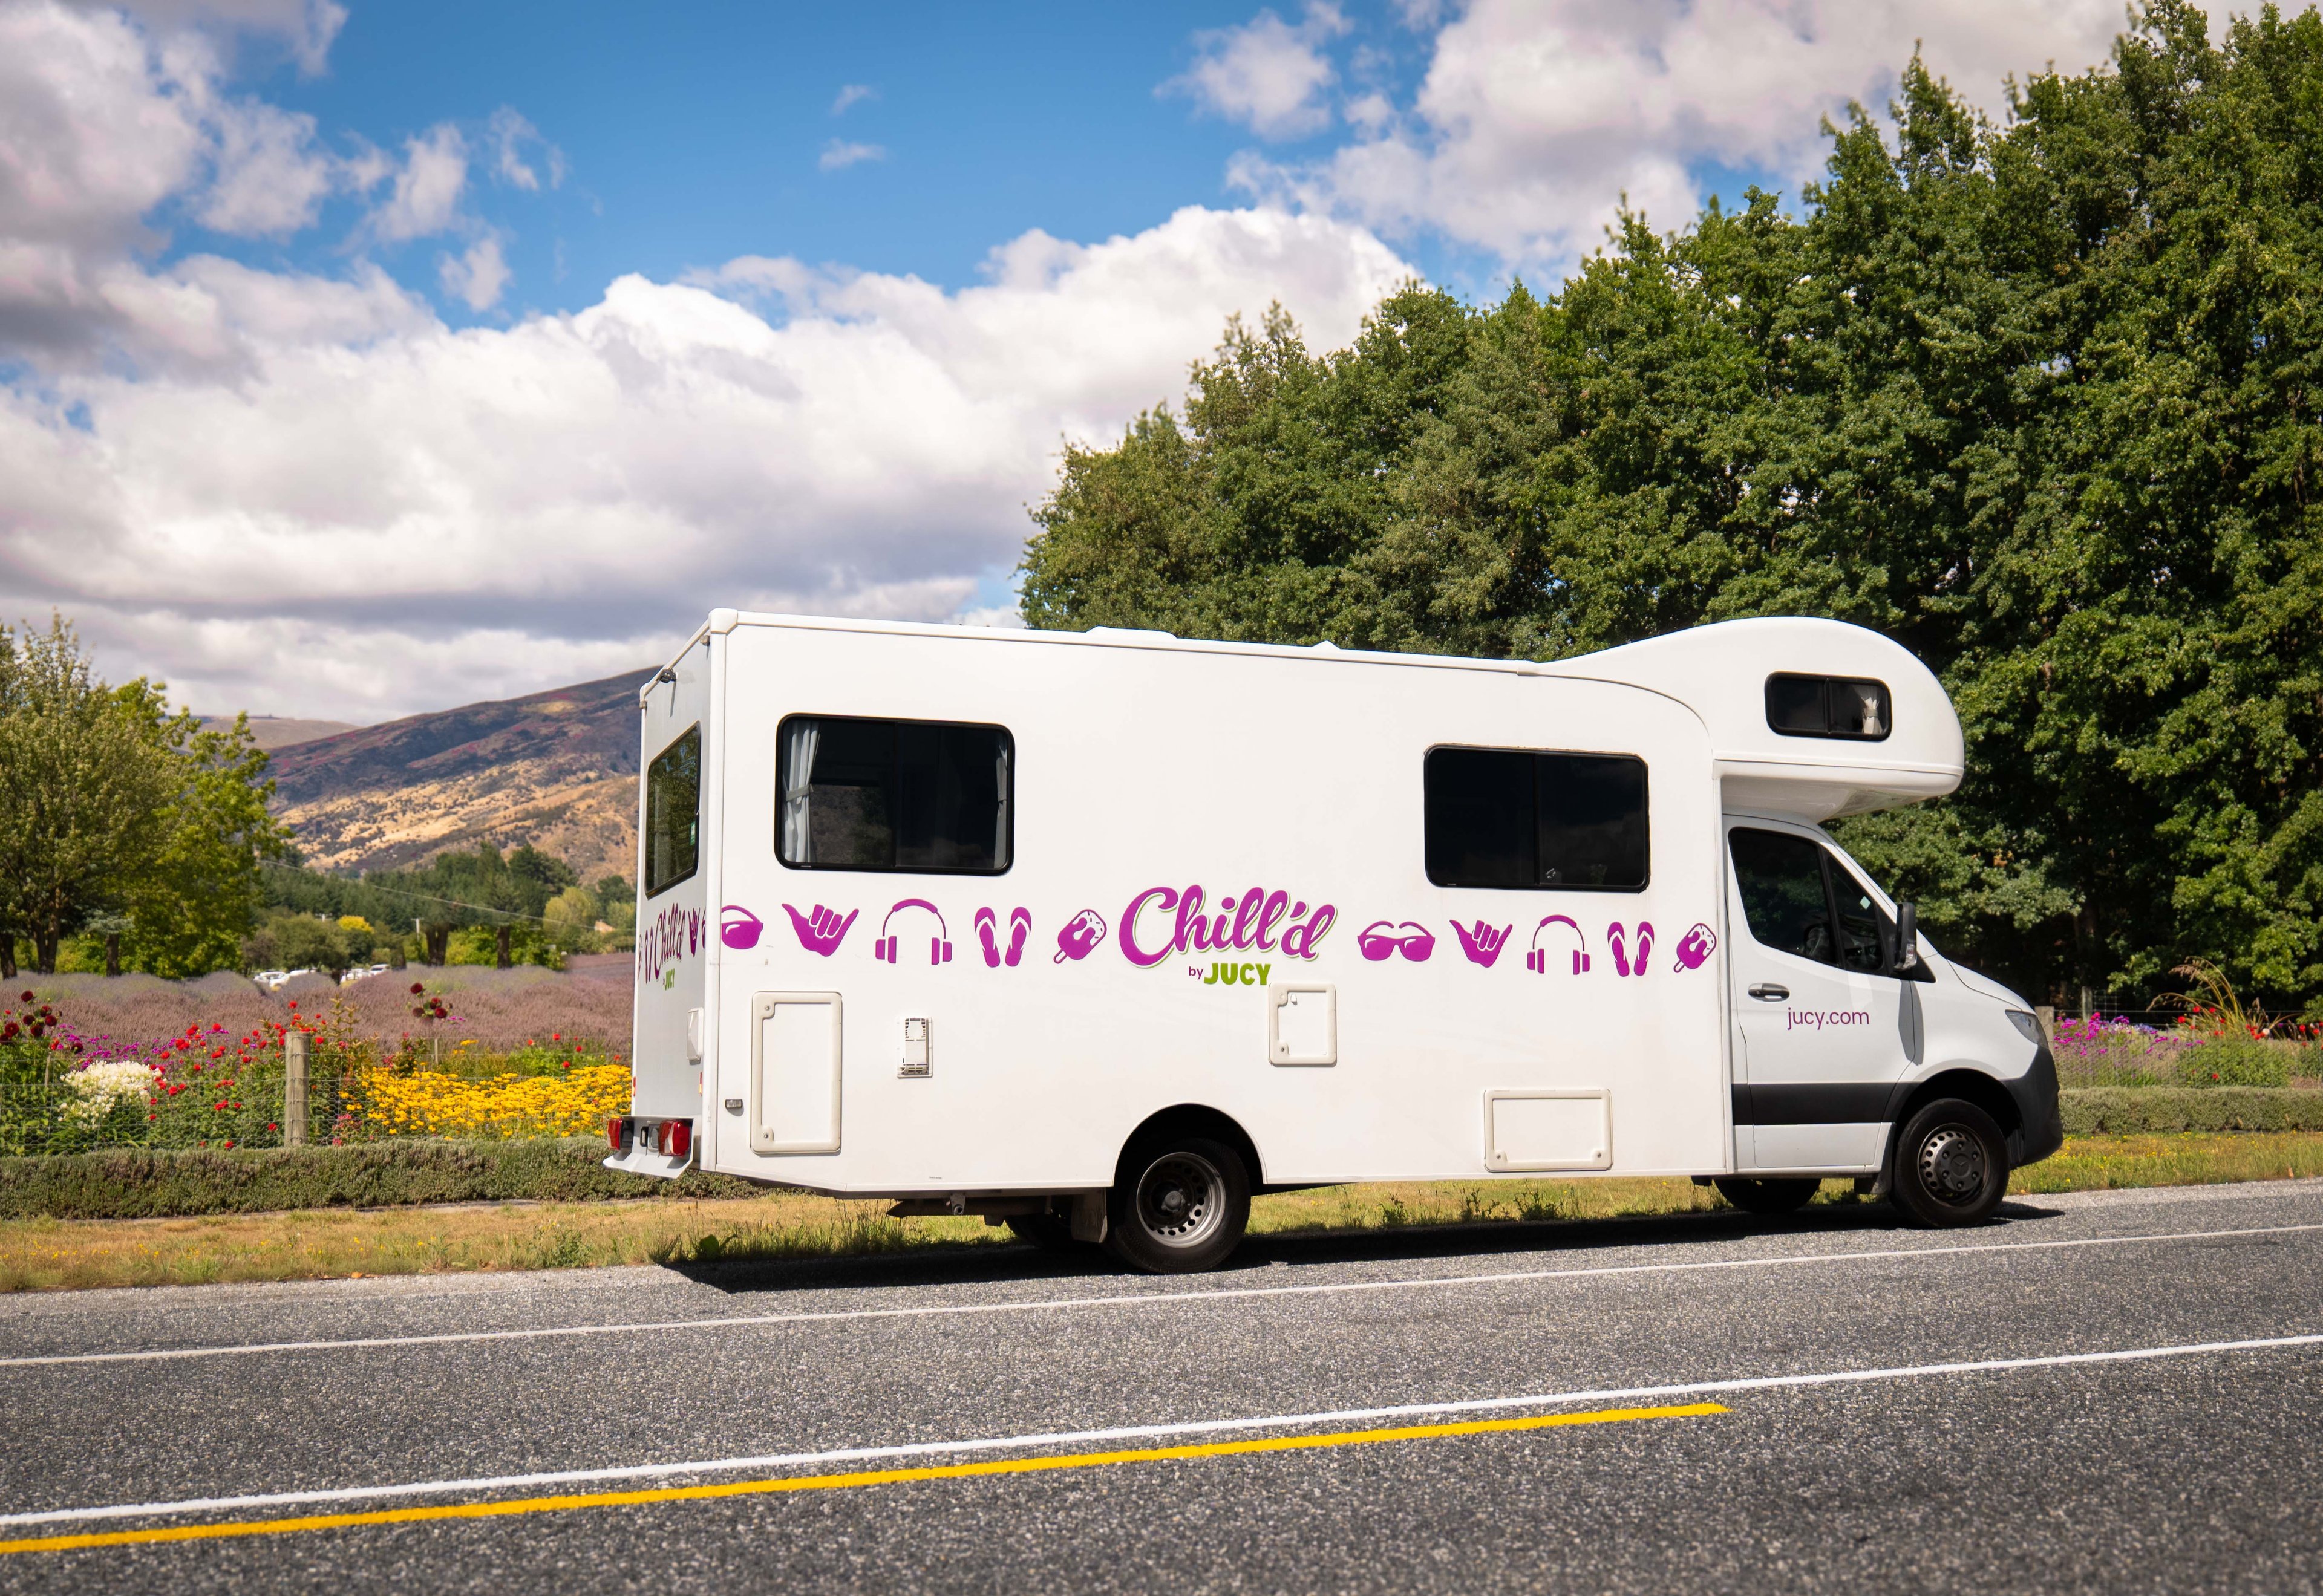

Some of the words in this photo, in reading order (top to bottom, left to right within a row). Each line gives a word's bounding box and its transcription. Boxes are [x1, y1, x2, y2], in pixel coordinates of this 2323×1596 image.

[655, 902, 685, 981] Chill'd
[1119, 884, 1338, 968] Chill'd
[1188, 966, 1204, 979] by
[1204, 963, 1271, 986] JUCY
[1788, 1007, 1870, 1030] jucy.com
